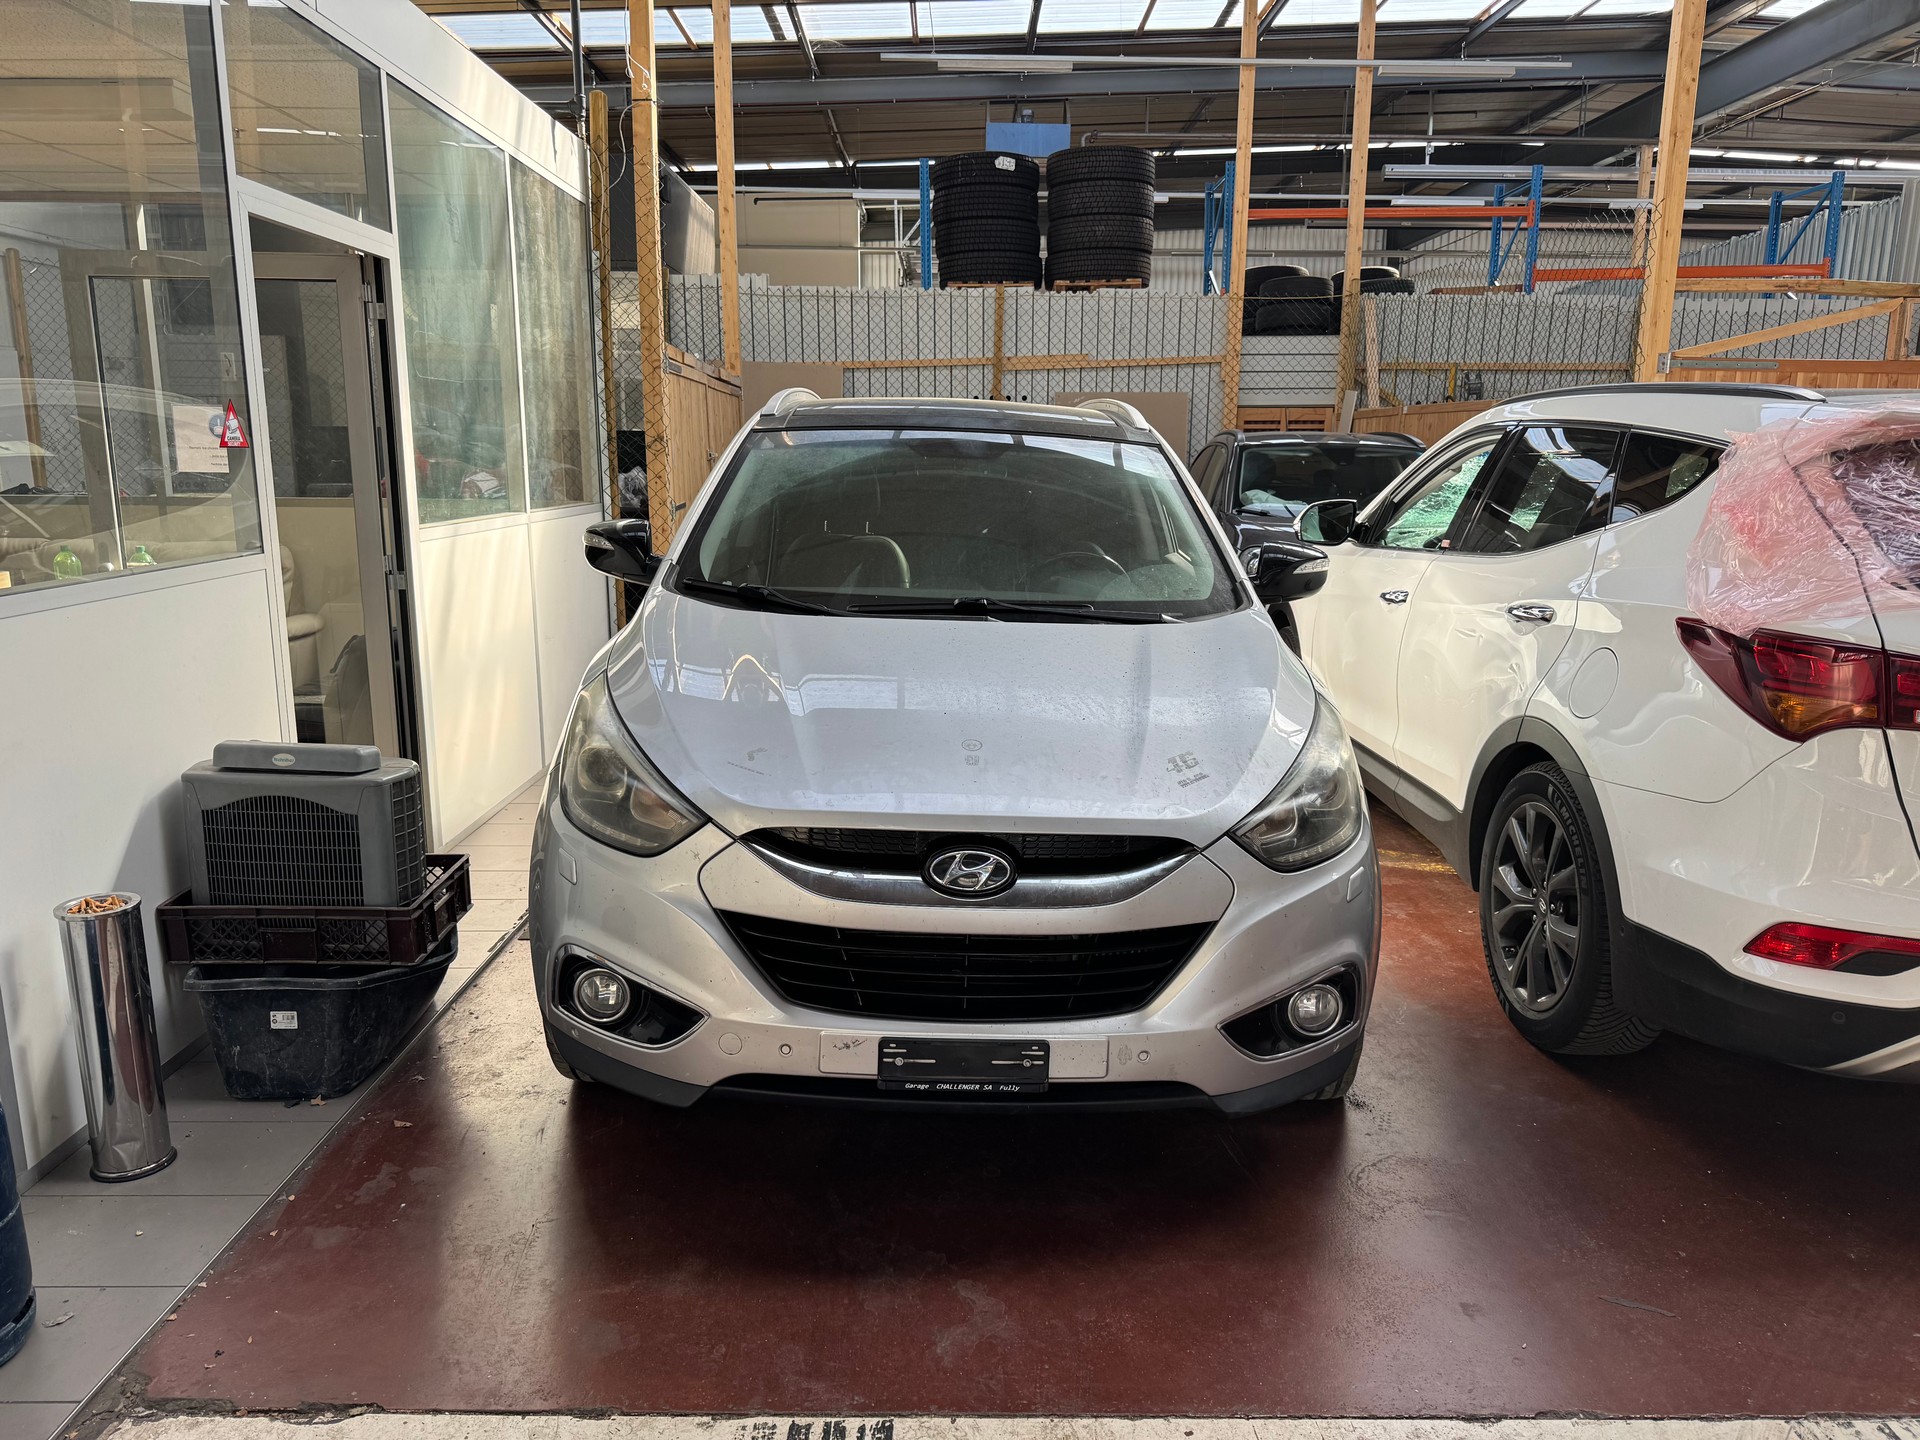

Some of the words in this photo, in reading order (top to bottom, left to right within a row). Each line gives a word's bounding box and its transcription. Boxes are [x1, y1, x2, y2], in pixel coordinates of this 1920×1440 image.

[1559, 806, 1588, 889] MICHELIN
[904, 1082, 930, 1091] Garage
[936, 1083, 980, 1091] CHALLENGER
